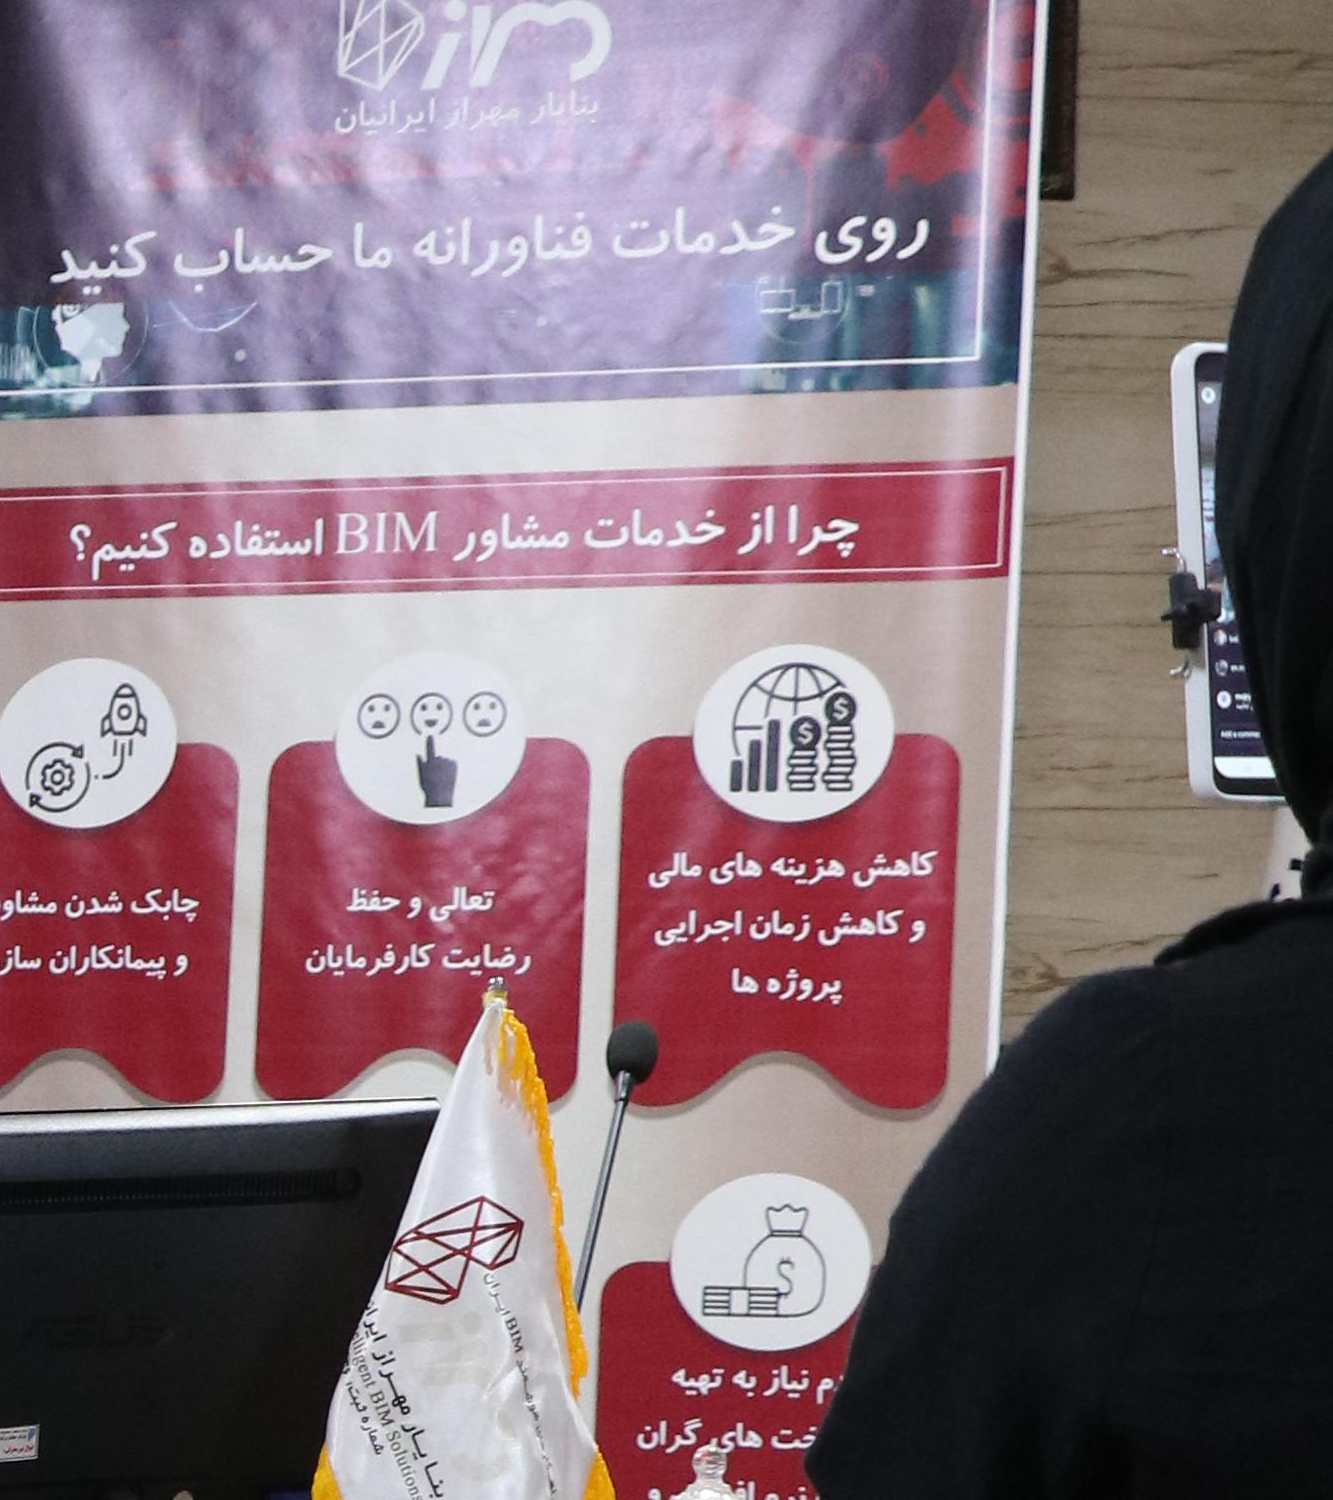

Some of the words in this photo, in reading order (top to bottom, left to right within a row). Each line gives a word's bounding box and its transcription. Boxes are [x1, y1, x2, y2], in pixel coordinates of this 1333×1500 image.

[351, 222, 393, 270] ما
[412, 210, 594, 278] فناورانه
[613, 205, 797, 262] خدمات
[815, 213, 930, 268] روی
[48, 231, 158, 295] کنید
[173, 227, 335, 297] حساب
[187, 516, 324, 560] استفاده
[334, 511, 439, 556] BIM
[453, 512, 570, 566] مشاور
[583, 507, 726, 554] خدمات
[737, 504, 775, 557] از
[787, 509, 860, 558] چرا
[69, 520, 177, 580] کنیم؟
[648, 851, 702, 888] مالی
[709, 851, 763, 885] های
[770, 855, 846, 885] هزینه
[852, 850, 938, 888] کاهش
[64, 890, 124, 919] شدن
[131, 888, 200, 923] چابک
[346, 889, 401, 912] حفظ
[407, 896, 423, 918] و
[429, 886, 496, 922] تعالی
[654, 909, 743, 947] اجرایی
[749, 909, 811, 942] زمان
[817, 909, 904, 947] کاهش
[908, 919, 926, 944] و
[48, 944, 168, 980] پیمانکاران
[172, 953, 189, 977] و
[304, 942, 435, 977] کارفرمایان
[442, 942, 532, 976] رضایت
[732, 967, 759, 994] ها
[766, 967, 842, 1006] پروژه
[504, 1316, 525, 1355] BIM
[670, 1367, 726, 1396] تهیه
[732, 1369, 758, 1397] به
[762, 1364, 811, 1399] نیاز
[370, 1391, 395, 1428] BIM
[636, 1417, 704, 1454] گران
[709, 1421, 765, 1453] های
